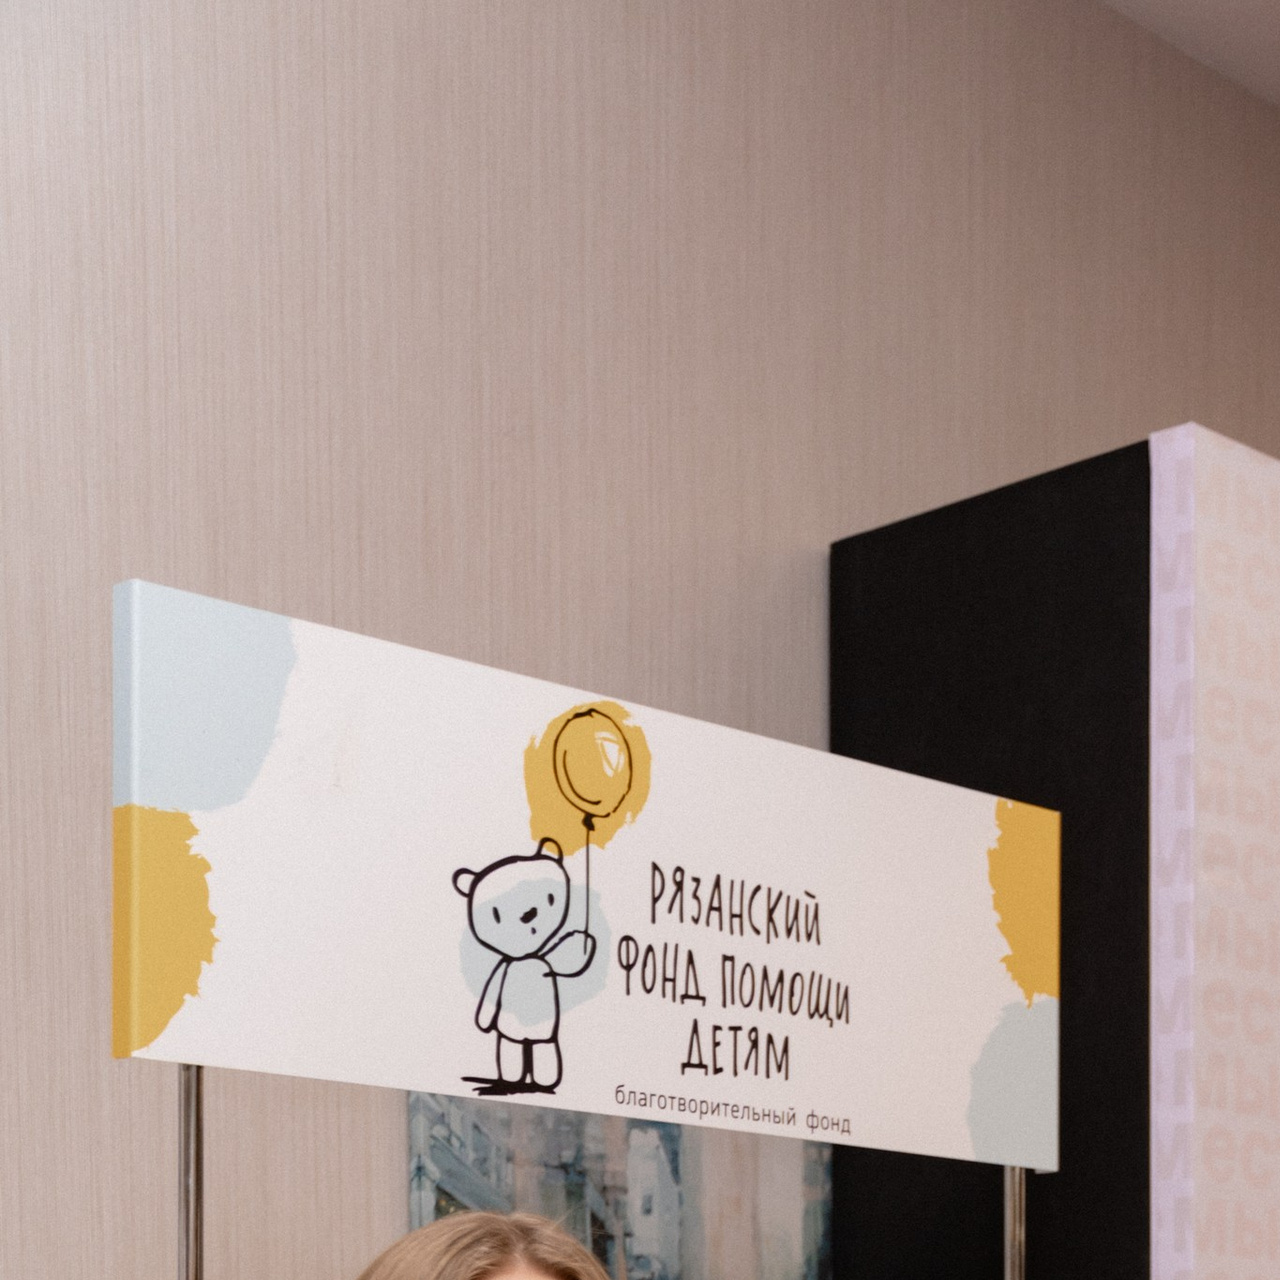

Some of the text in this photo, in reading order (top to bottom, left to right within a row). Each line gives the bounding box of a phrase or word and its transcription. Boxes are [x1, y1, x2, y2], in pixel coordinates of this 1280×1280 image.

[651, 861, 820, 945] РЯЗАНСКИЙ
[618, 935, 849, 1028] ФОНД ПОМОЩИ
[681, 1018, 788, 1080] ДЕТЯМ
[615, 1084, 851, 1135] благотворительный фонд
